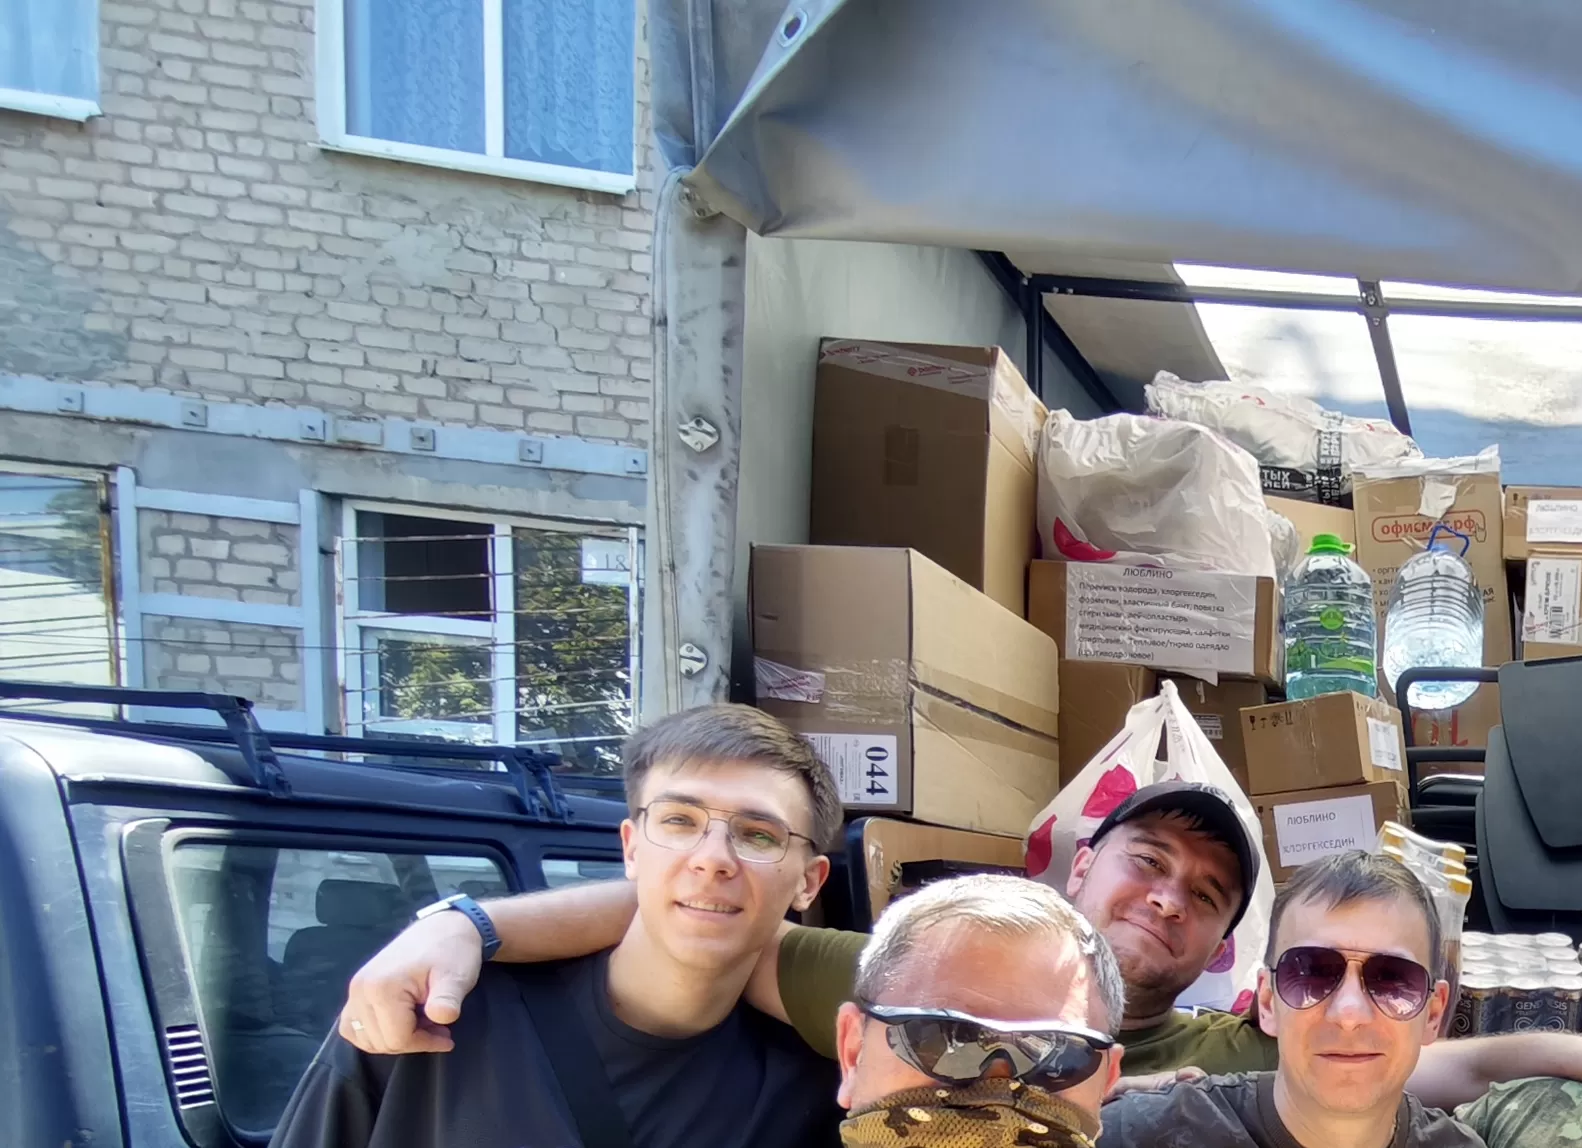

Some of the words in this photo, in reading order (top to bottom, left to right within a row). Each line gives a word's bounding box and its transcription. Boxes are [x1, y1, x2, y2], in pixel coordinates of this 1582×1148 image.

[1381, 515, 1476, 537] офисмг.рф
[1123, 568, 1174, 579] ЛЮБЛИНО
[865, 746, 889, 796] 044
[1286, 811, 1337, 826] ЛЮБЛИНО
[1282, 837, 1356, 854] ХЛОРГЕКСЕДИН
[1515, 1001, 1568, 1011] GENSIS
